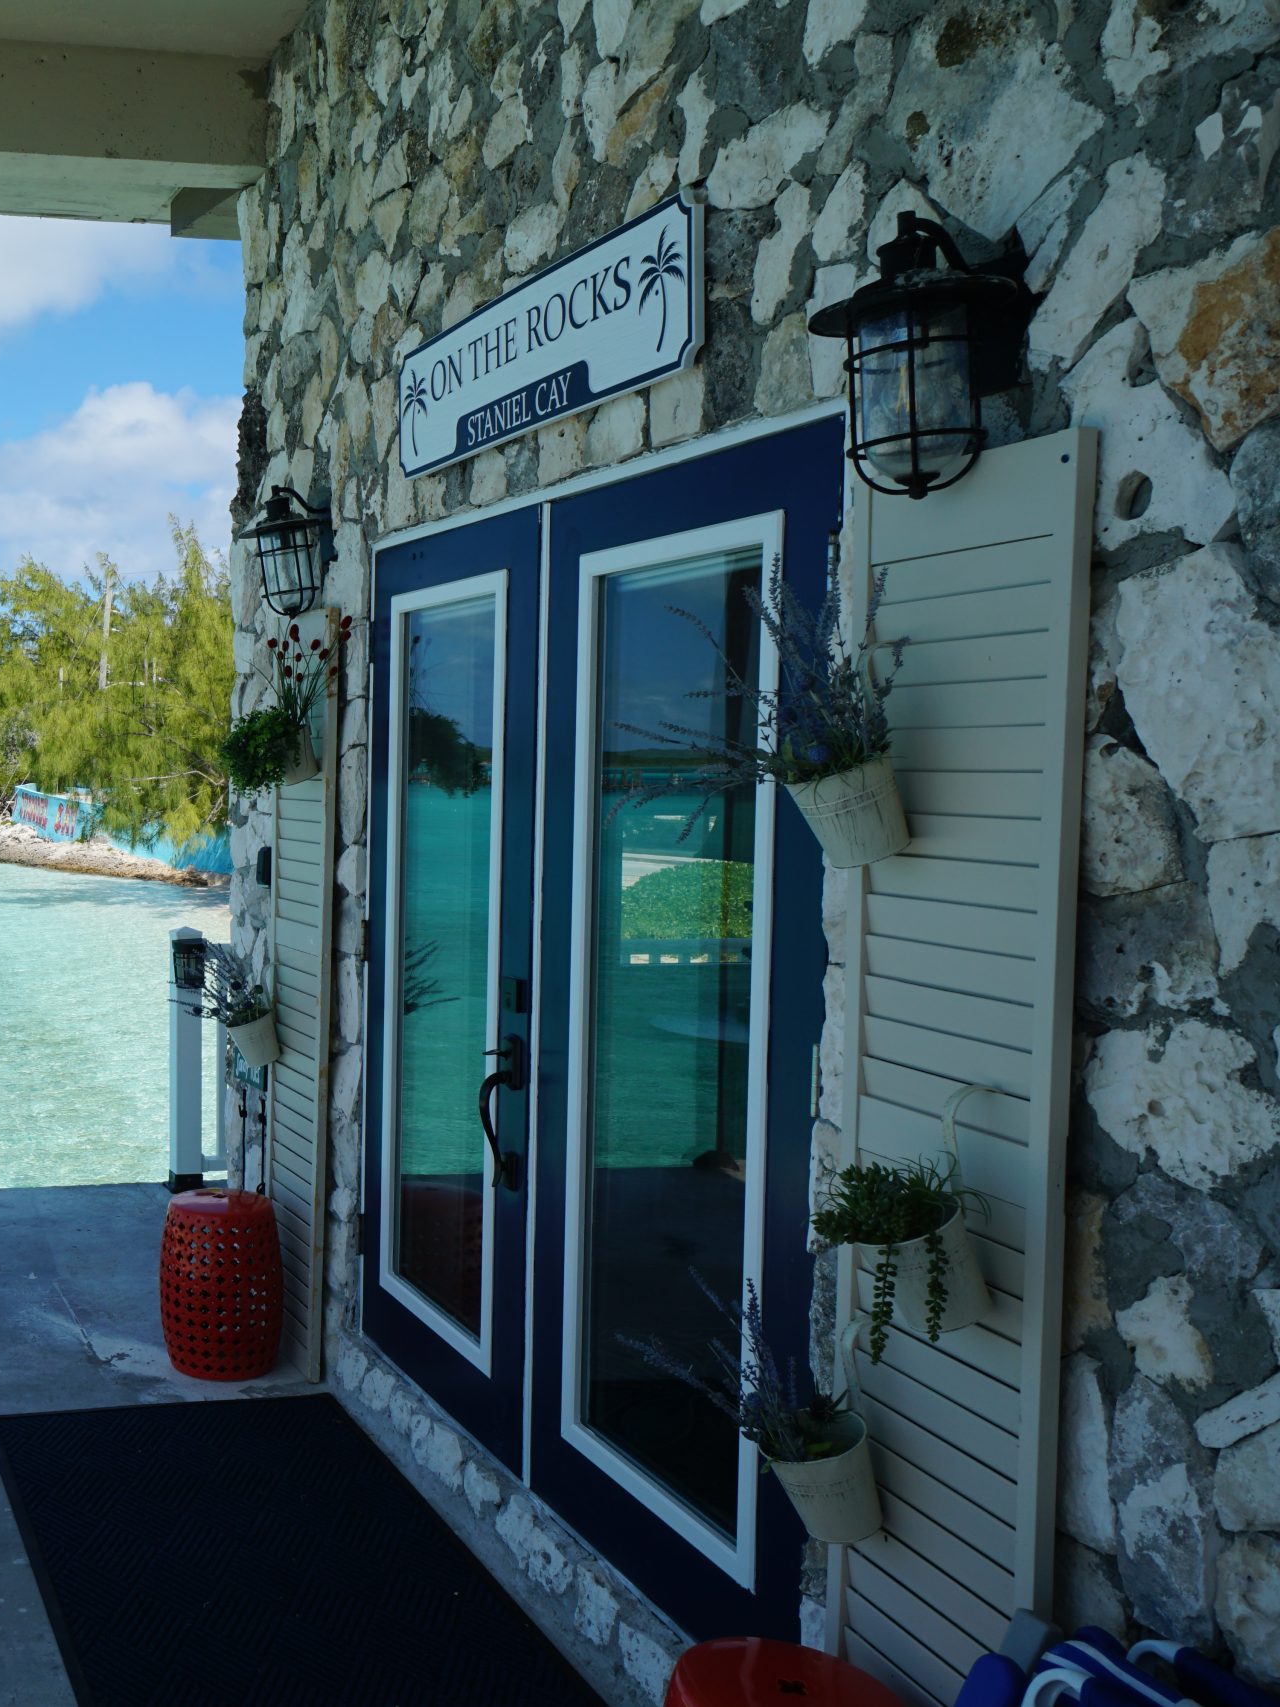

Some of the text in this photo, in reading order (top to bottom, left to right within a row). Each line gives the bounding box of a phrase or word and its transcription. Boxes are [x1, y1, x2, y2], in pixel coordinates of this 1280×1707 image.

[430, 255, 632, 402] ON THE ROCKS
[466, 371, 572, 447] STANIEL CAY
